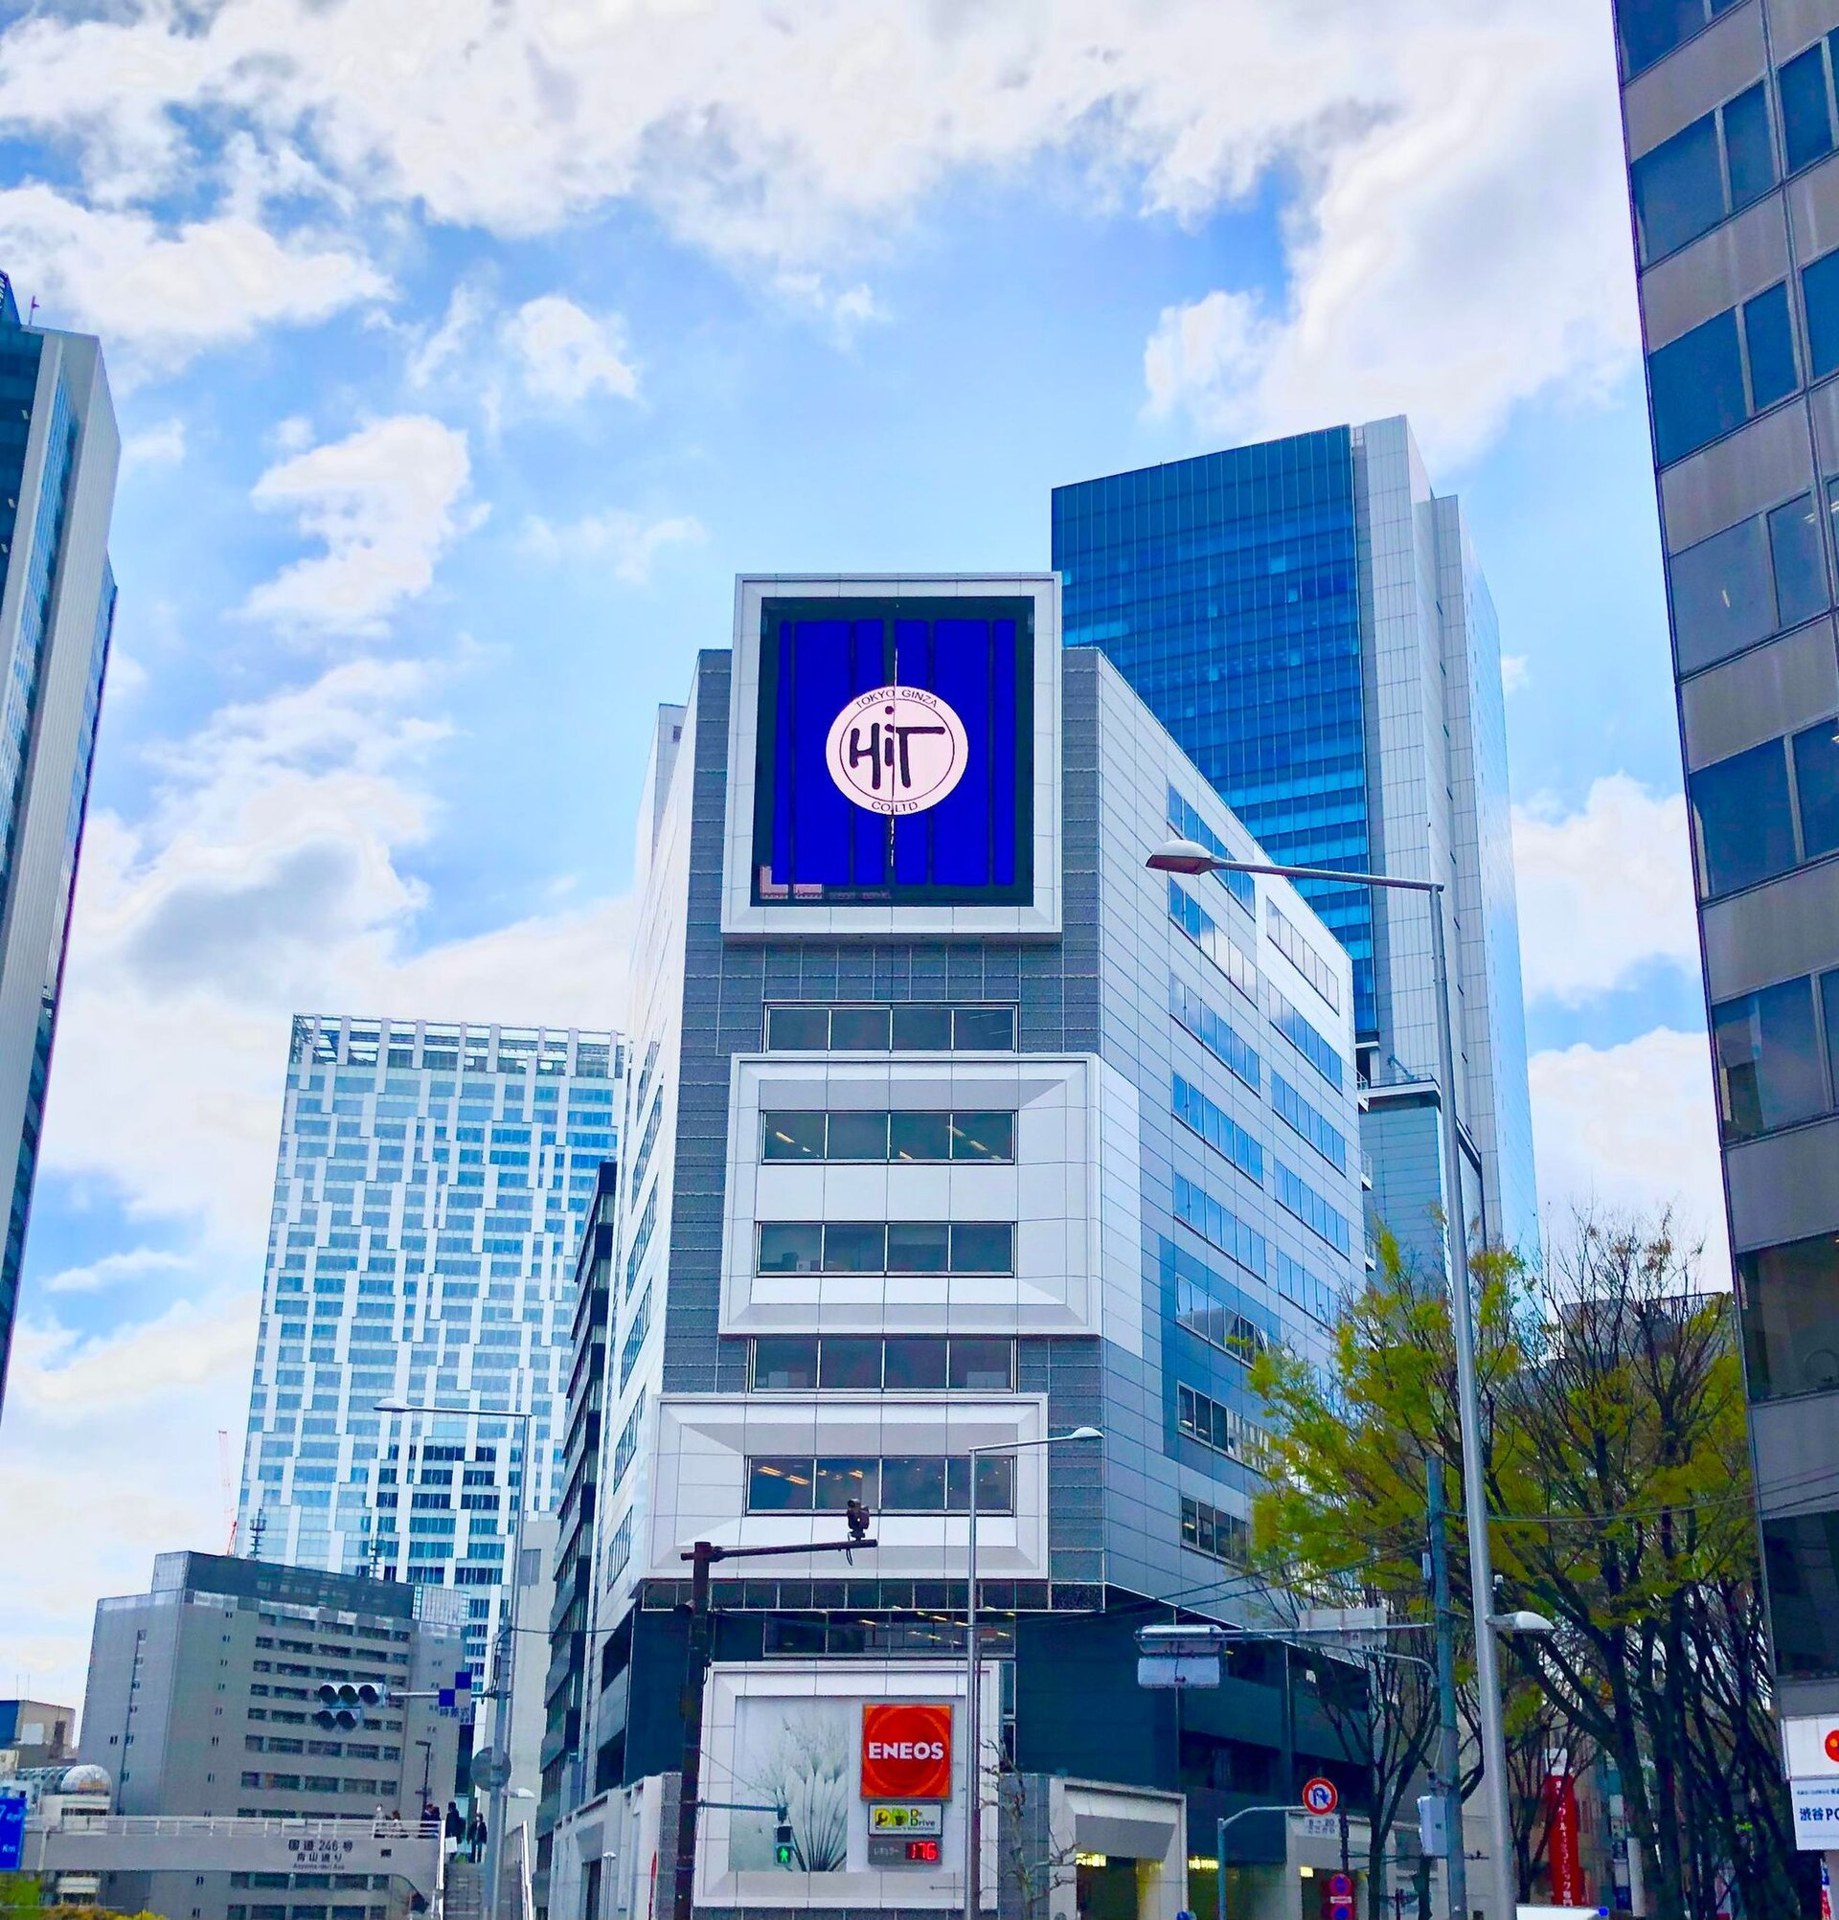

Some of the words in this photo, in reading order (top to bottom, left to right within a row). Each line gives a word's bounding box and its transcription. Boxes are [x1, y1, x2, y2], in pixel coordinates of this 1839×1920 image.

[855, 689, 896, 709] TOKYO
[901, 689, 938, 708] GINZA
[868, 1741, 944, 1760] ENEOS
[910, 1818, 936, 1826] Drive
[911, 1842, 936, 1860] 176
